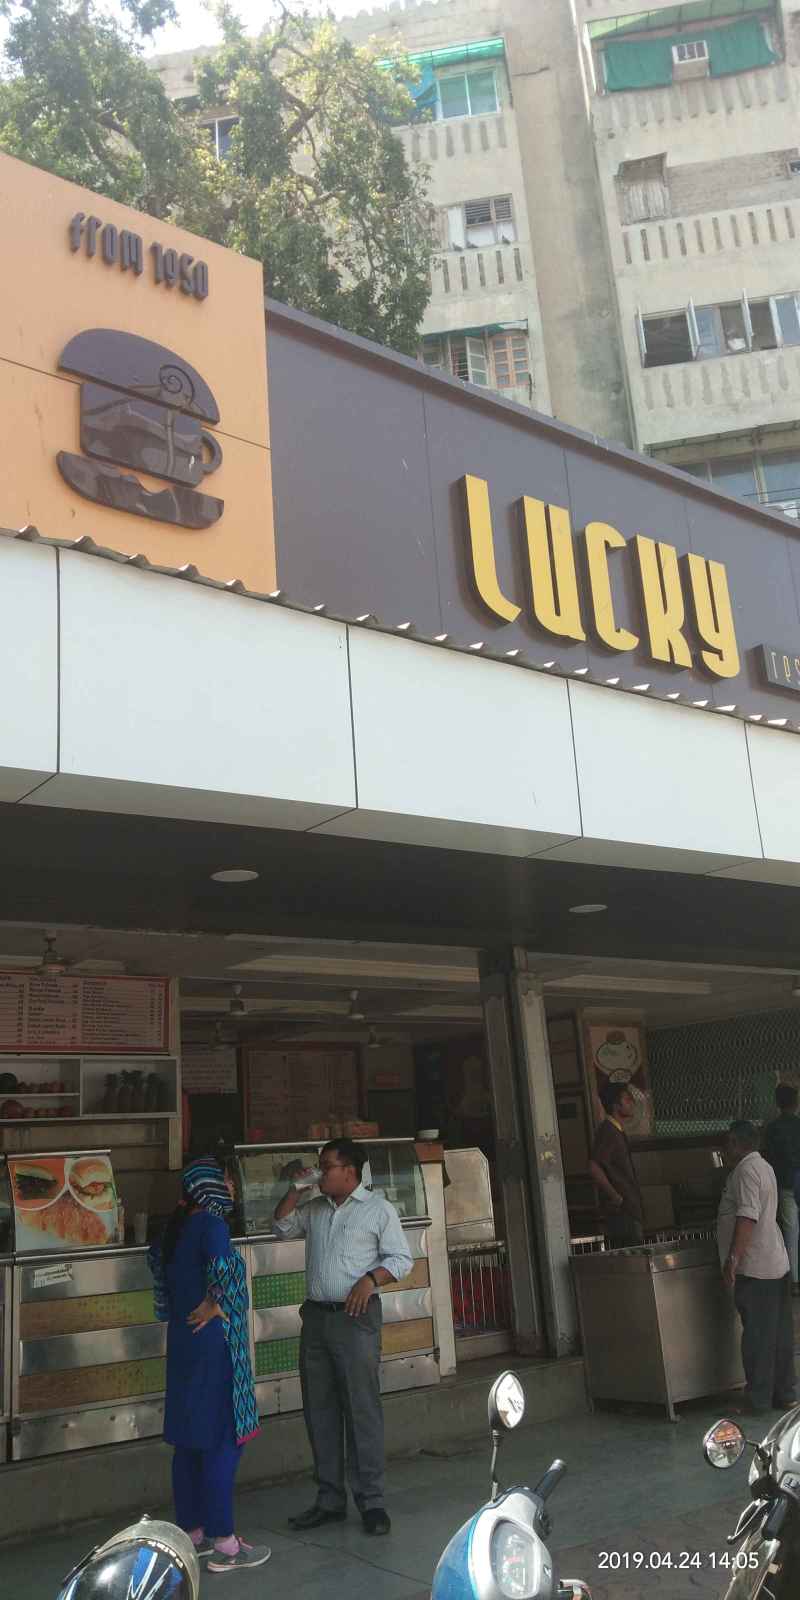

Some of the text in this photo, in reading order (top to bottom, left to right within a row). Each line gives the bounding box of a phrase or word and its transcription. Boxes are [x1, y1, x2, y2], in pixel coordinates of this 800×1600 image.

[69, 212, 208, 301] from 1950
[456, 473, 740, 679] LUCKY
